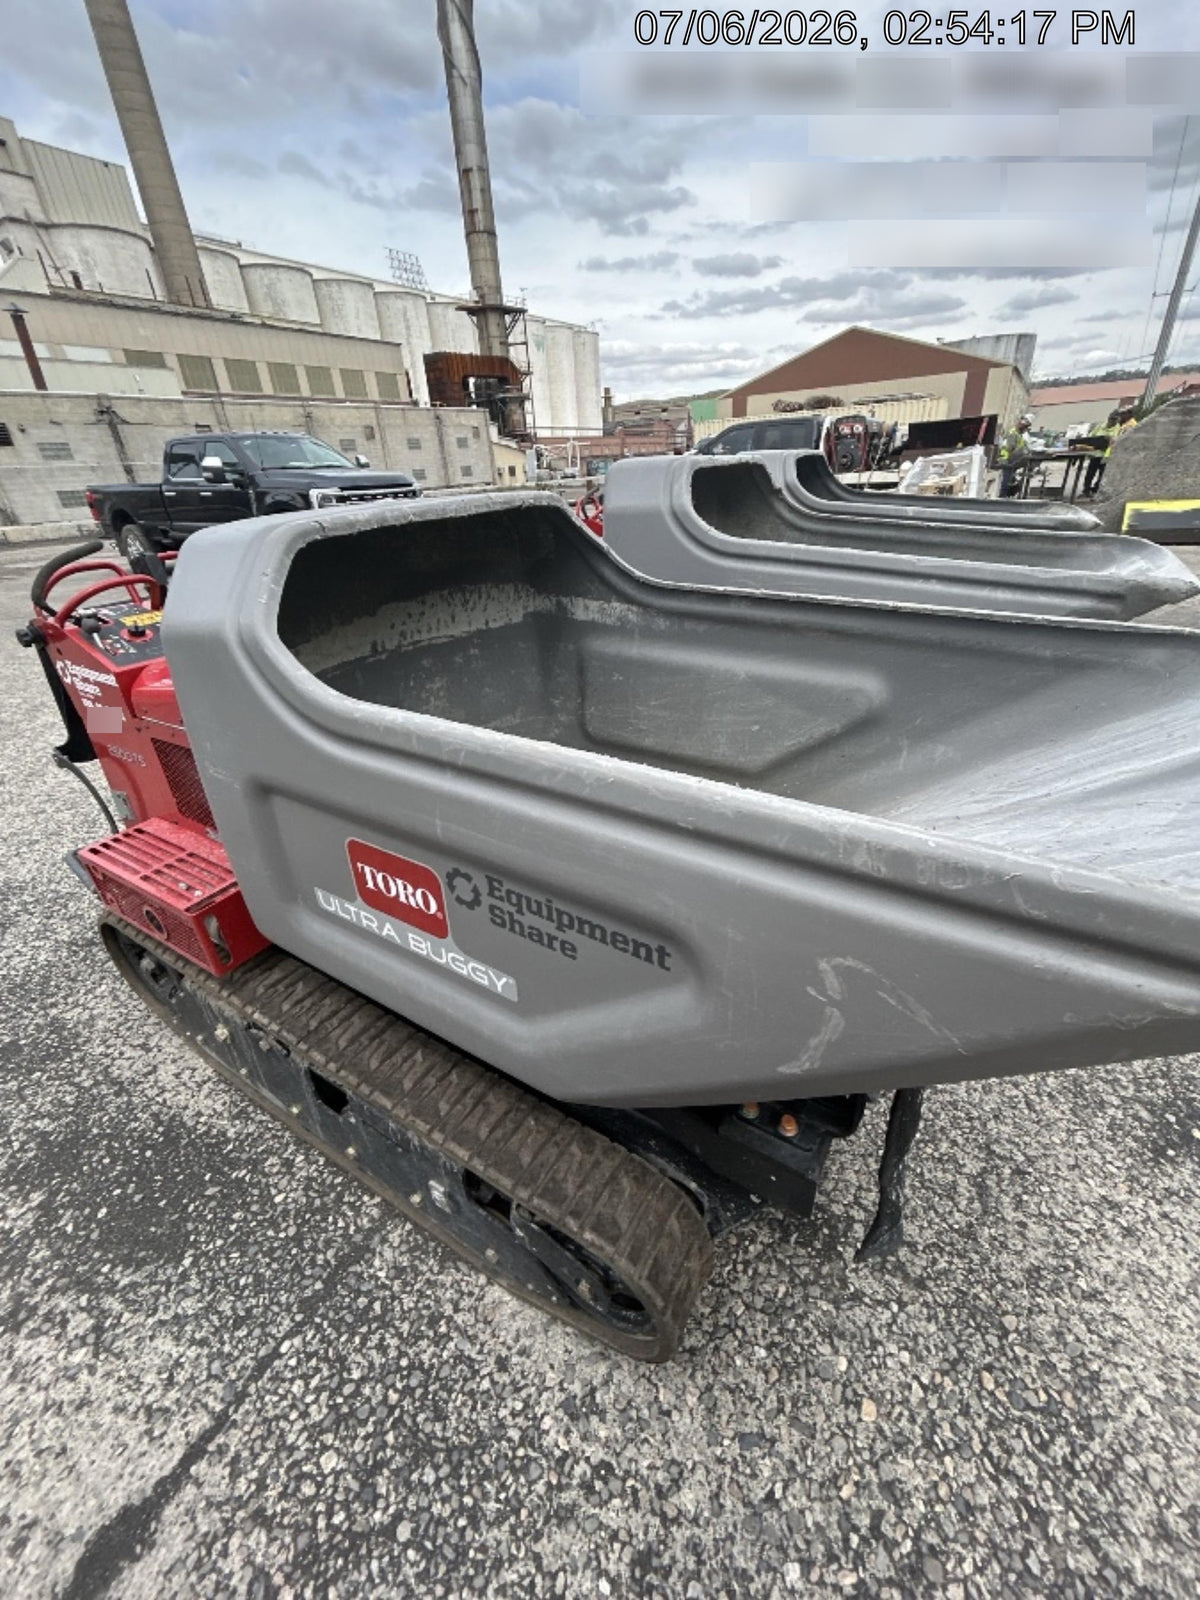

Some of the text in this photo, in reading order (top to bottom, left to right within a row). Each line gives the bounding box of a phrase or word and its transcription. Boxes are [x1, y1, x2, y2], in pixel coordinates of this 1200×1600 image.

[356, 861, 438, 915] TORO
[485, 874, 672, 972] Equipment
[317, 889, 507, 993] ULTRA BUGGY
[489, 904, 578, 961] Share
